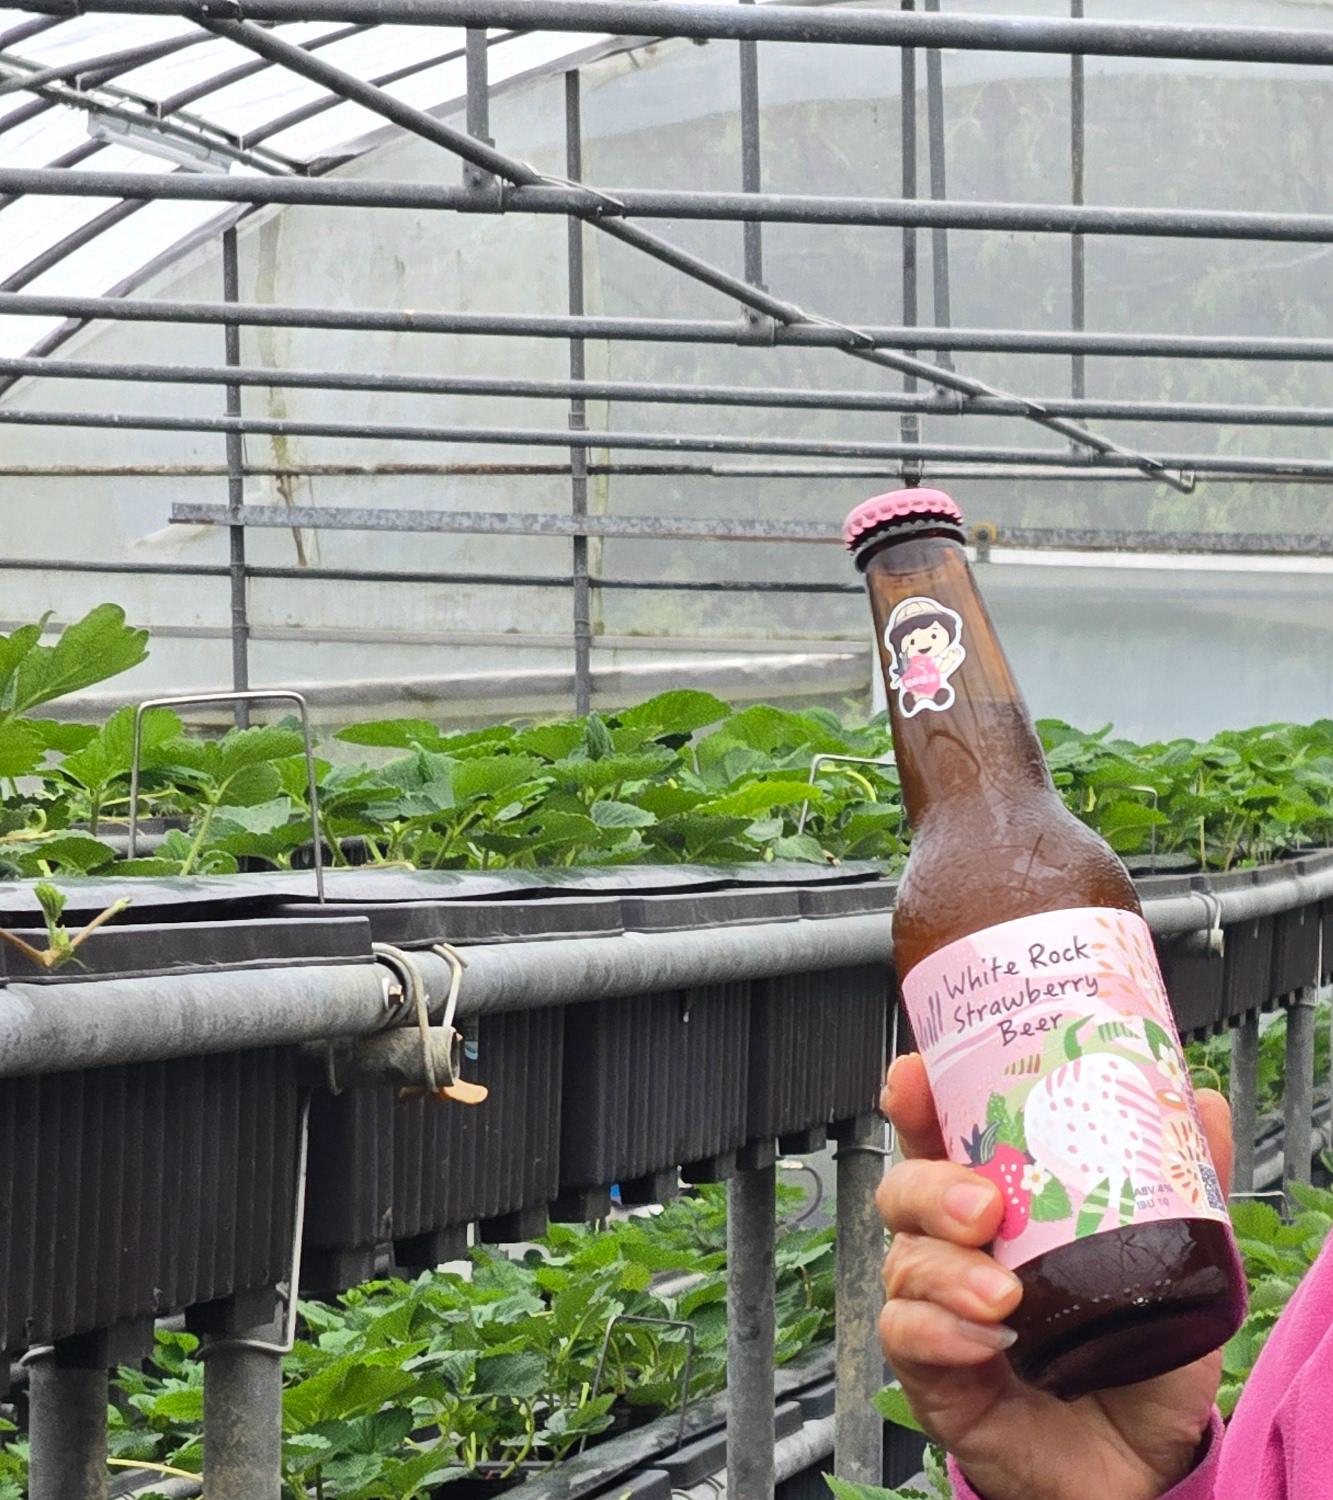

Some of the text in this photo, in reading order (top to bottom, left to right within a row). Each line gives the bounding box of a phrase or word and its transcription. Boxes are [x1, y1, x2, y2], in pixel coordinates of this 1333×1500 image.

[943, 935, 1091, 1000] White Rock
[954, 975, 1099, 1034] Strawberry
[997, 1013, 1063, 1047] Beer
[1134, 1185, 1155, 1196] ABV
